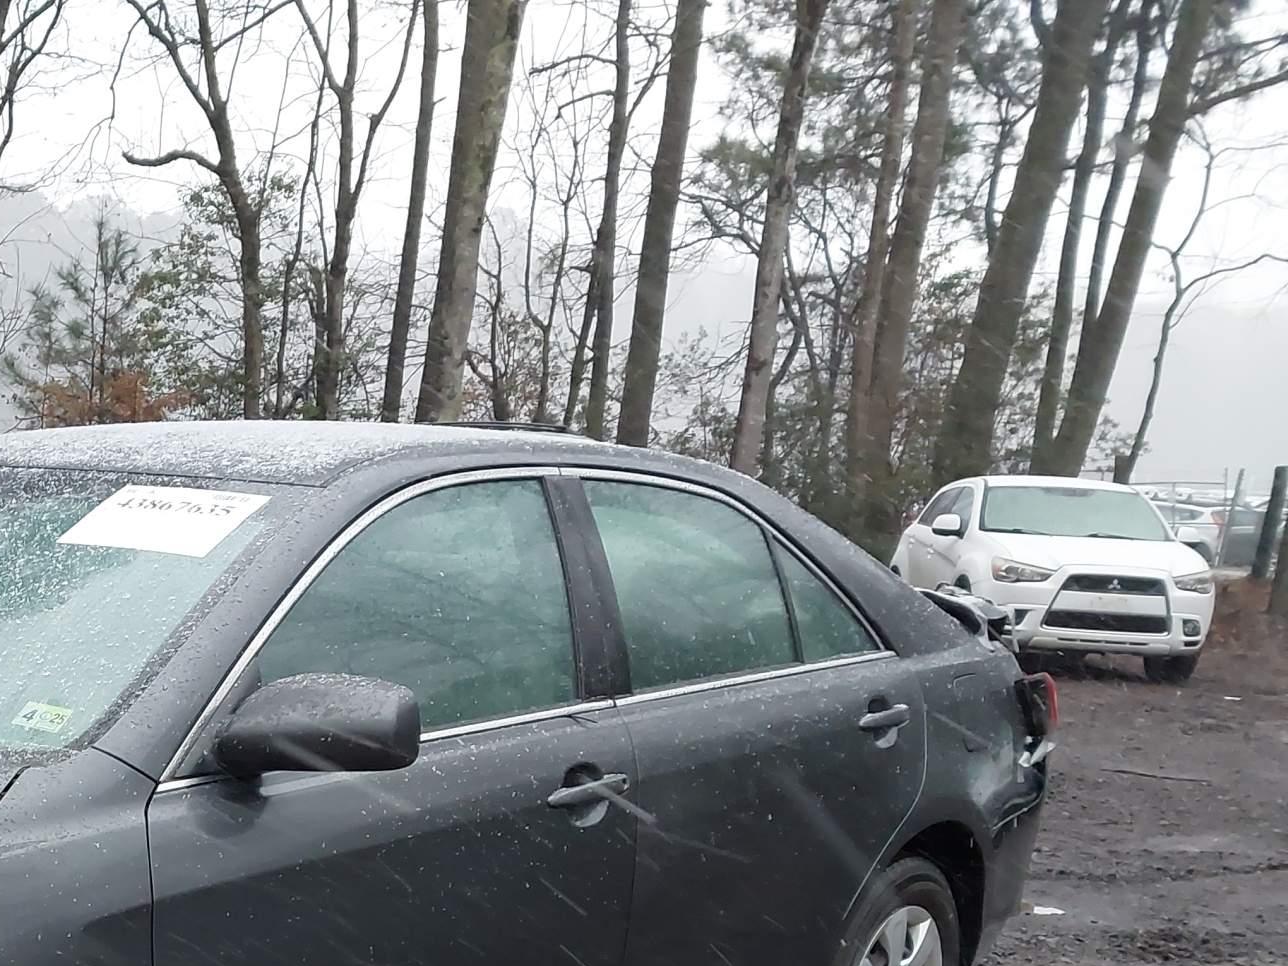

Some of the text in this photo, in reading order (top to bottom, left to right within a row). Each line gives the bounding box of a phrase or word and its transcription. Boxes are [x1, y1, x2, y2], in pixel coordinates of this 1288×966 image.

[117, 497, 237, 517] 43867635
[22, 709, 66, 726] 4 25
